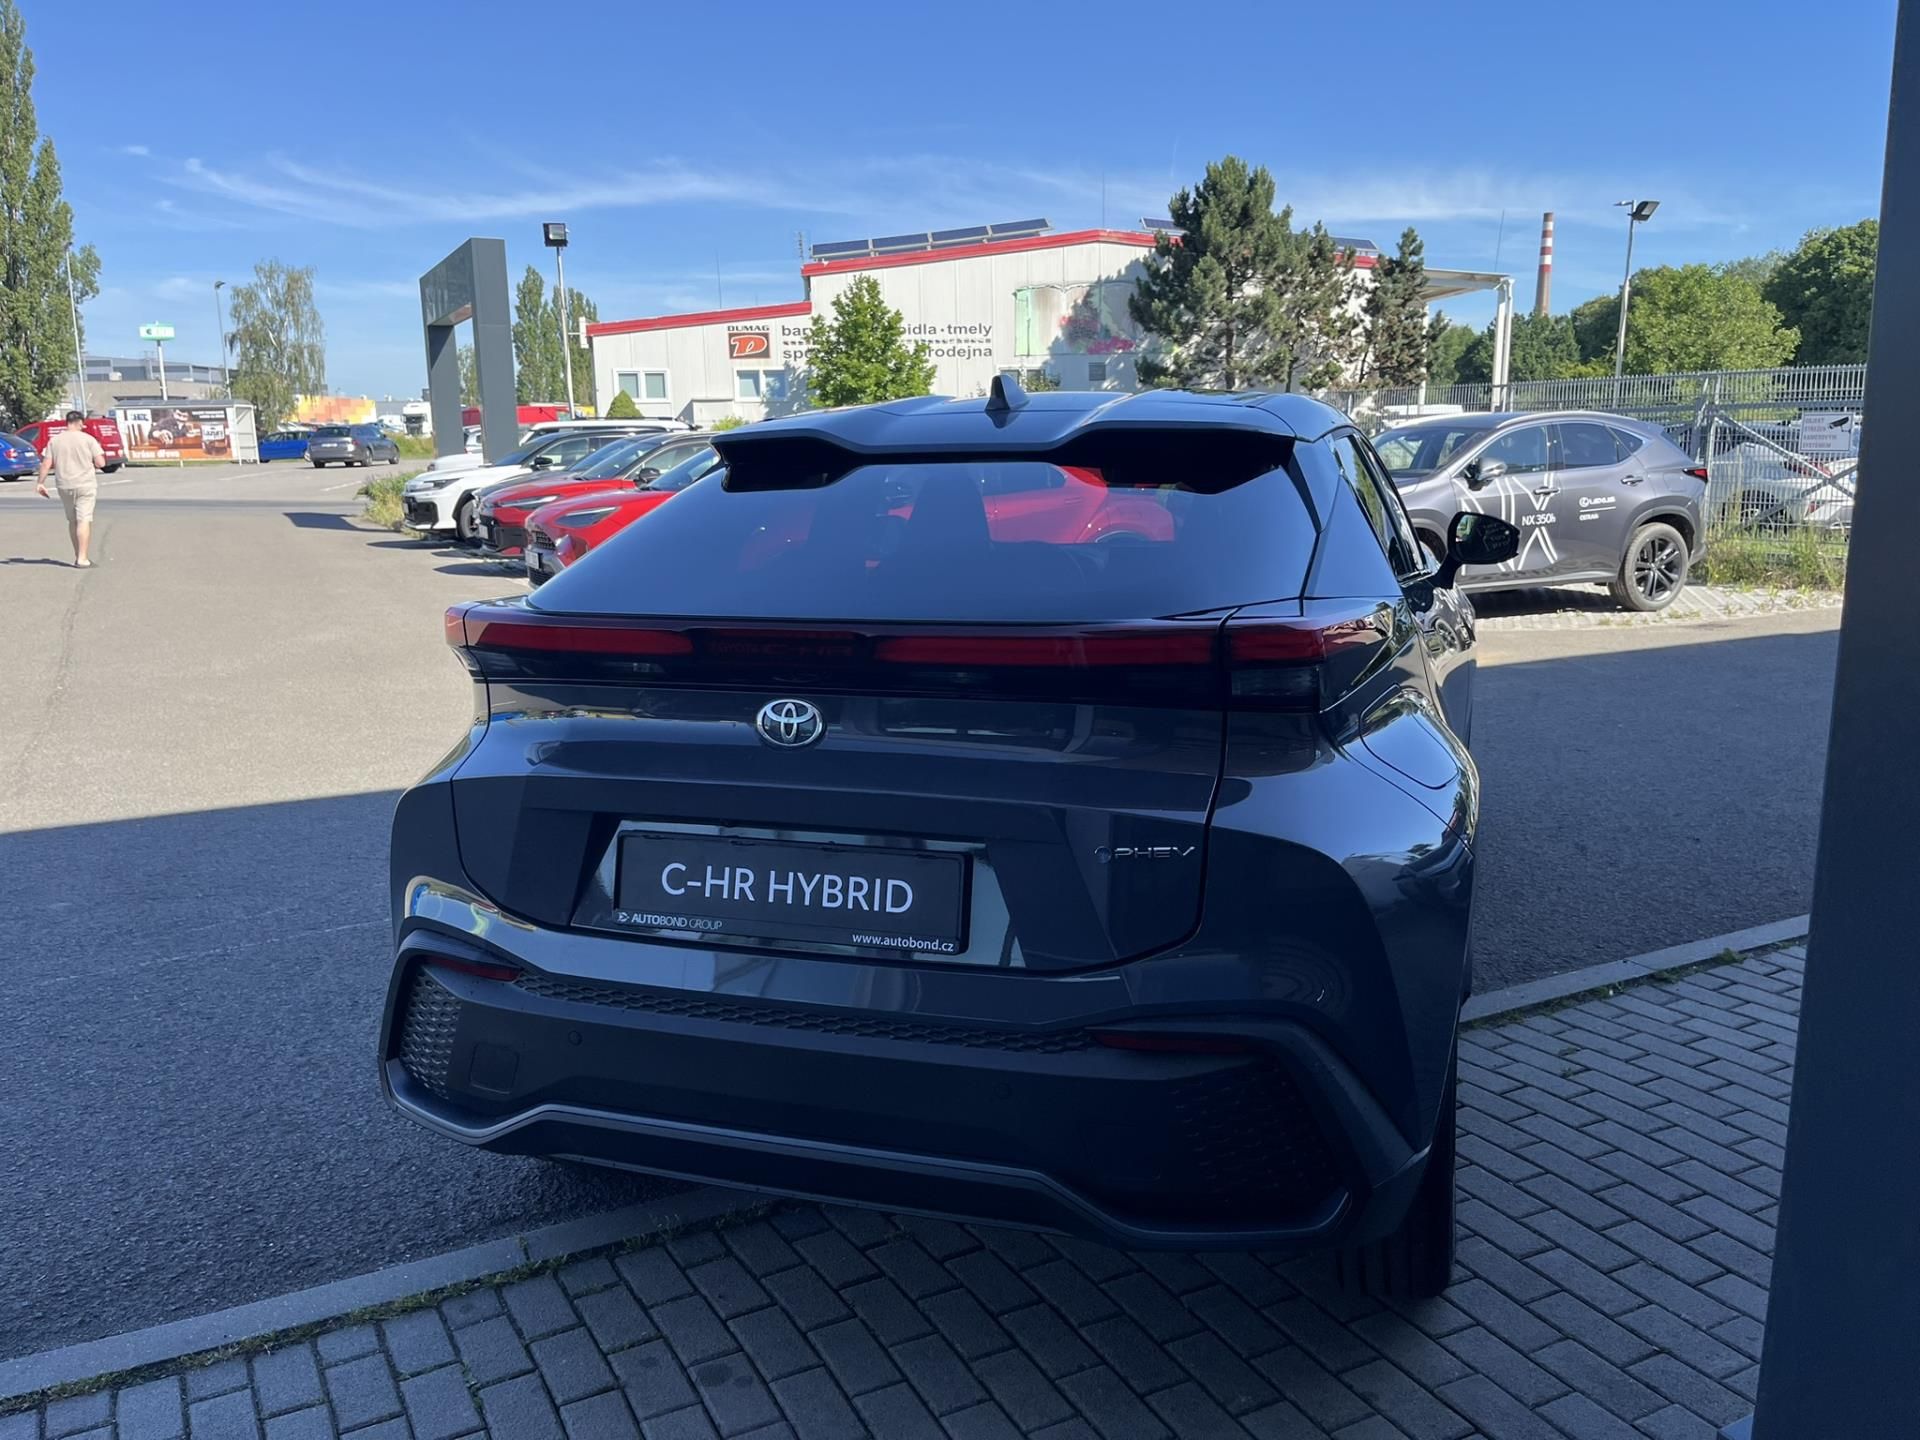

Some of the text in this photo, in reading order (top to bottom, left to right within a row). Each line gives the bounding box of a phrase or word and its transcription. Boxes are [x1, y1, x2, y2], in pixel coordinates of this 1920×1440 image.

[727, 324, 770, 332] DUMAG
[946, 322, 993, 337] tmely
[1521, 512, 1557, 526] NX 350h
[661, 862, 914, 914] C-HR HYBRID
[631, 913, 723, 930] AUTOBOND GROUP
[852, 934, 954, 952] www.autobond.cz
